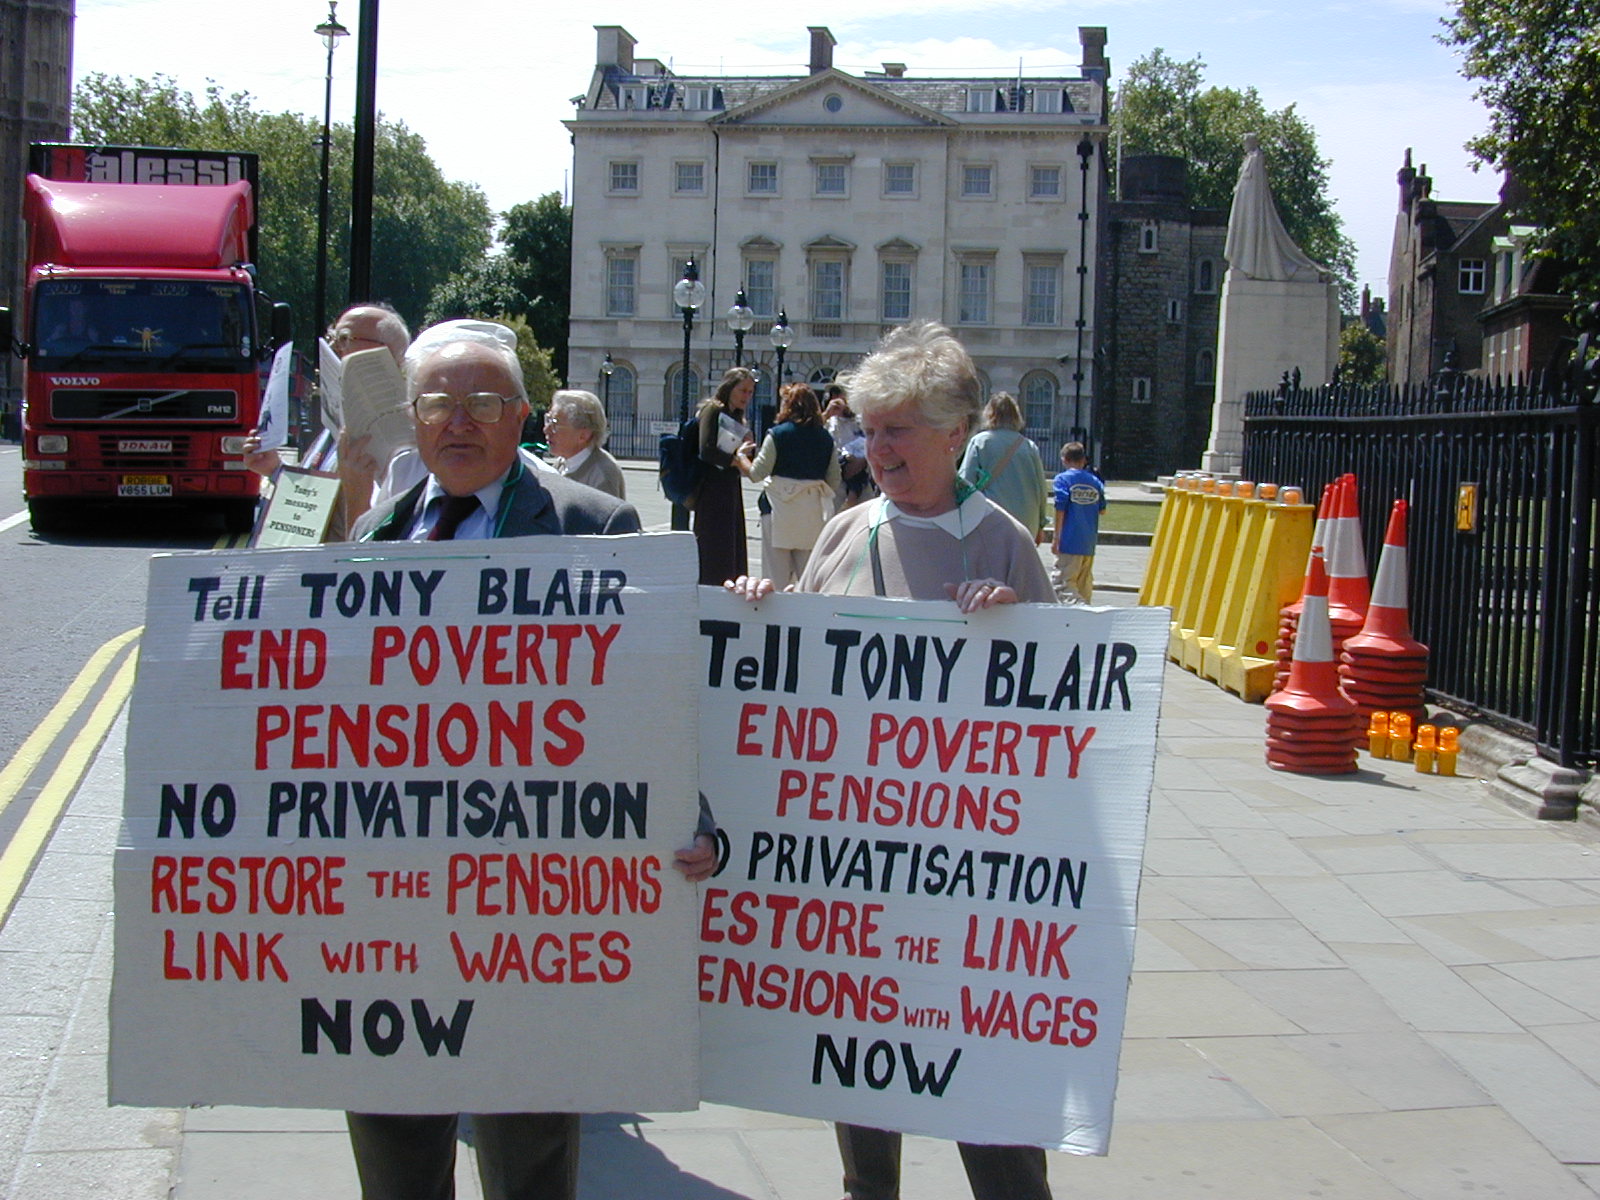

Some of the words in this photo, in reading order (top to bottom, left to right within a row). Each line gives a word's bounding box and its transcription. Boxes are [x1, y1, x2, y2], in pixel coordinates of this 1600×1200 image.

[51, 377, 100, 385] VOLVO
[284, 498, 318, 512] message
[293, 512, 301, 520] to
[294, 484, 318, 497] Tony's
[269, 520, 316, 538] PENSIONERS
[188, 576, 264, 621] Tell
[301, 570, 446, 618] TONY
[478, 568, 626, 616] BLAIR
[223, 629, 326, 689] END
[371, 624, 620, 685] POVERTY
[699, 620, 801, 693] Tell
[825, 629, 967, 703] TONY
[985, 640, 1136, 711] BLAIR
[256, 700, 585, 770] PENSIONS
[738, 704, 838, 761] END
[866, 714, 1095, 778] POVERTY
[157, 783, 236, 839] NO
[267, 779, 648, 839] PRIVATISATION
[778, 769, 1020, 834] PENSIONS
[153, 856, 346, 915] RESTORE
[367, 872, 430, 897] THE
[448, 854, 662, 915] PENSIONS
[747, 831, 1087, 908] PRIVATISATION
[165, 930, 288, 981] LINK
[322, 940, 418, 972] WITH
[451, 931, 631, 983] WAGES
[700, 889, 883, 958] ESTORE
[897, 936, 939, 963] THE
[965, 916, 1076, 978] LINK
[301, 997, 475, 1057] NOW
[699, 955, 898, 1023] ENSIONS
[904, 1006, 950, 1030] WITH
[962, 987, 1097, 1046] WAGES
[812, 1034, 961, 1097] NOW
